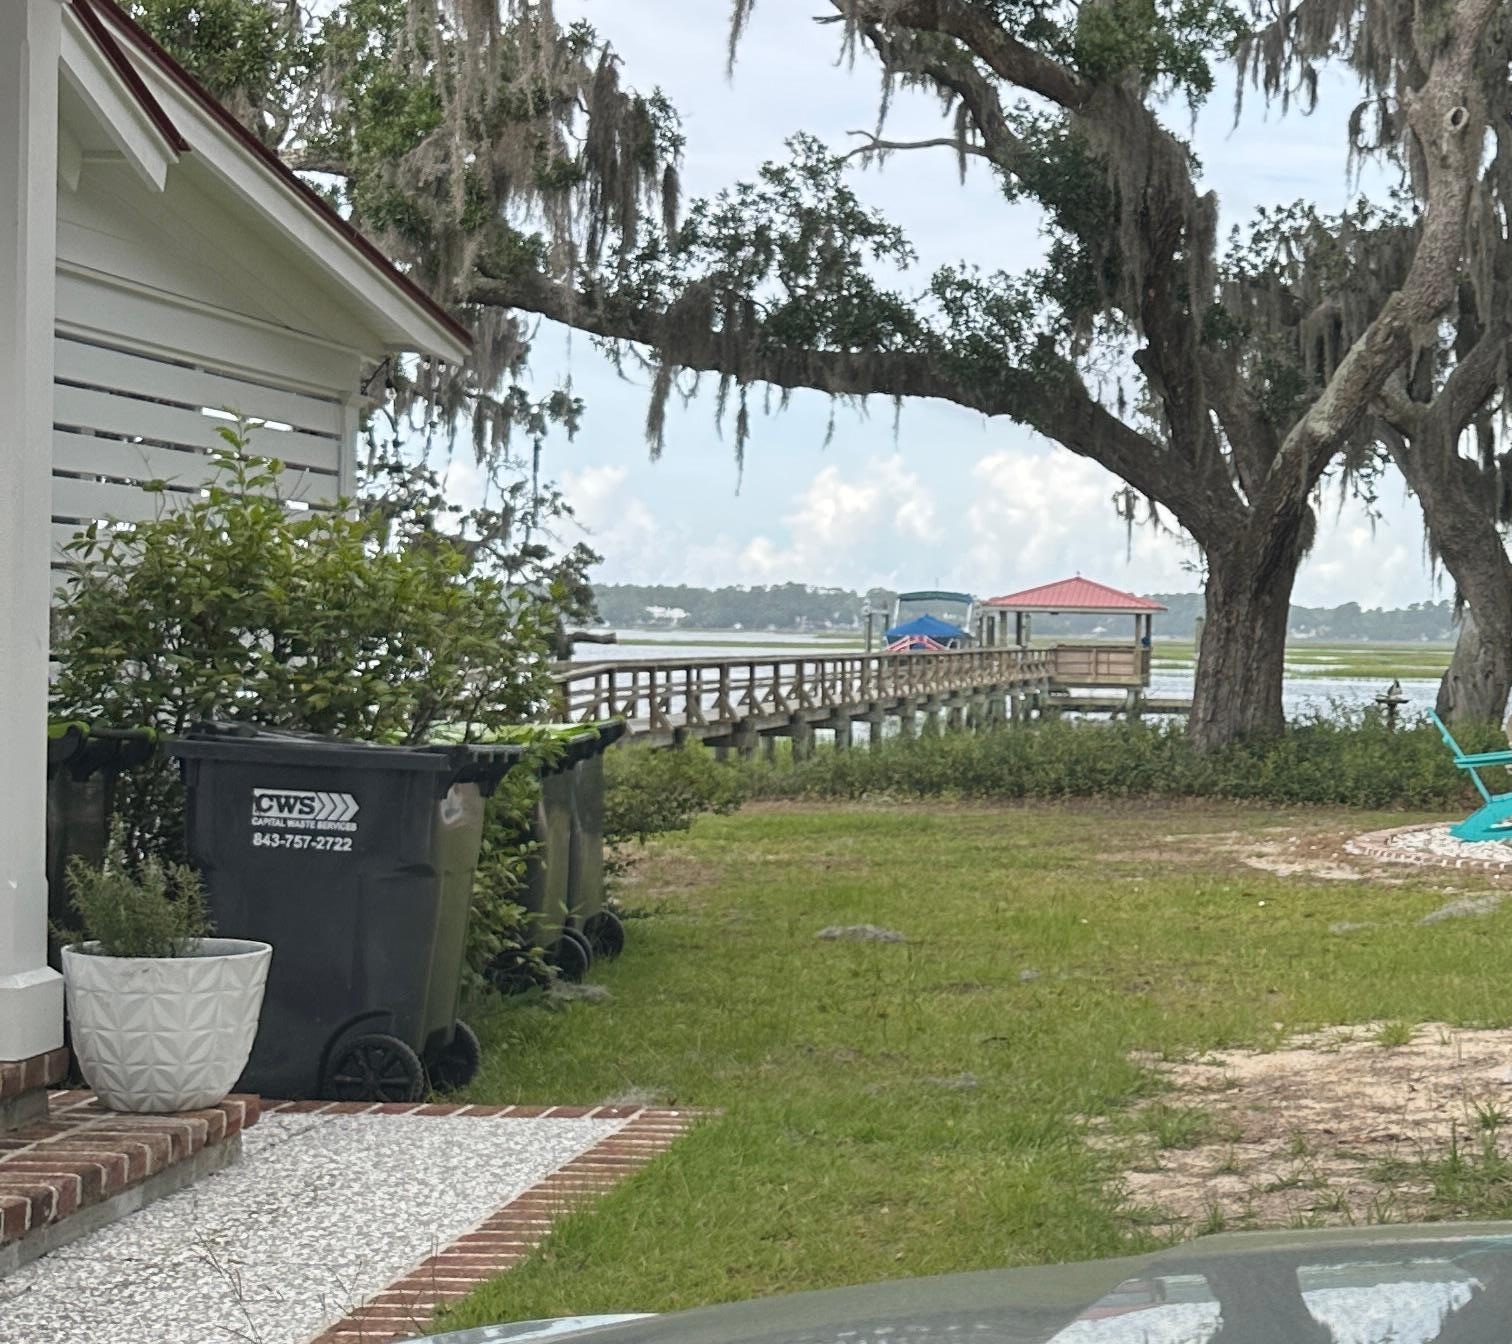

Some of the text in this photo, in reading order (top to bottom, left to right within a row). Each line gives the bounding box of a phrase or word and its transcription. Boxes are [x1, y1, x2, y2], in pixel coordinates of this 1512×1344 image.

[254, 794, 316, 815] CWS
[251, 817, 286, 827] CAPITAL
[287, 819, 316, 829] WASTE
[253, 832, 353, 851] 843-757-2722
